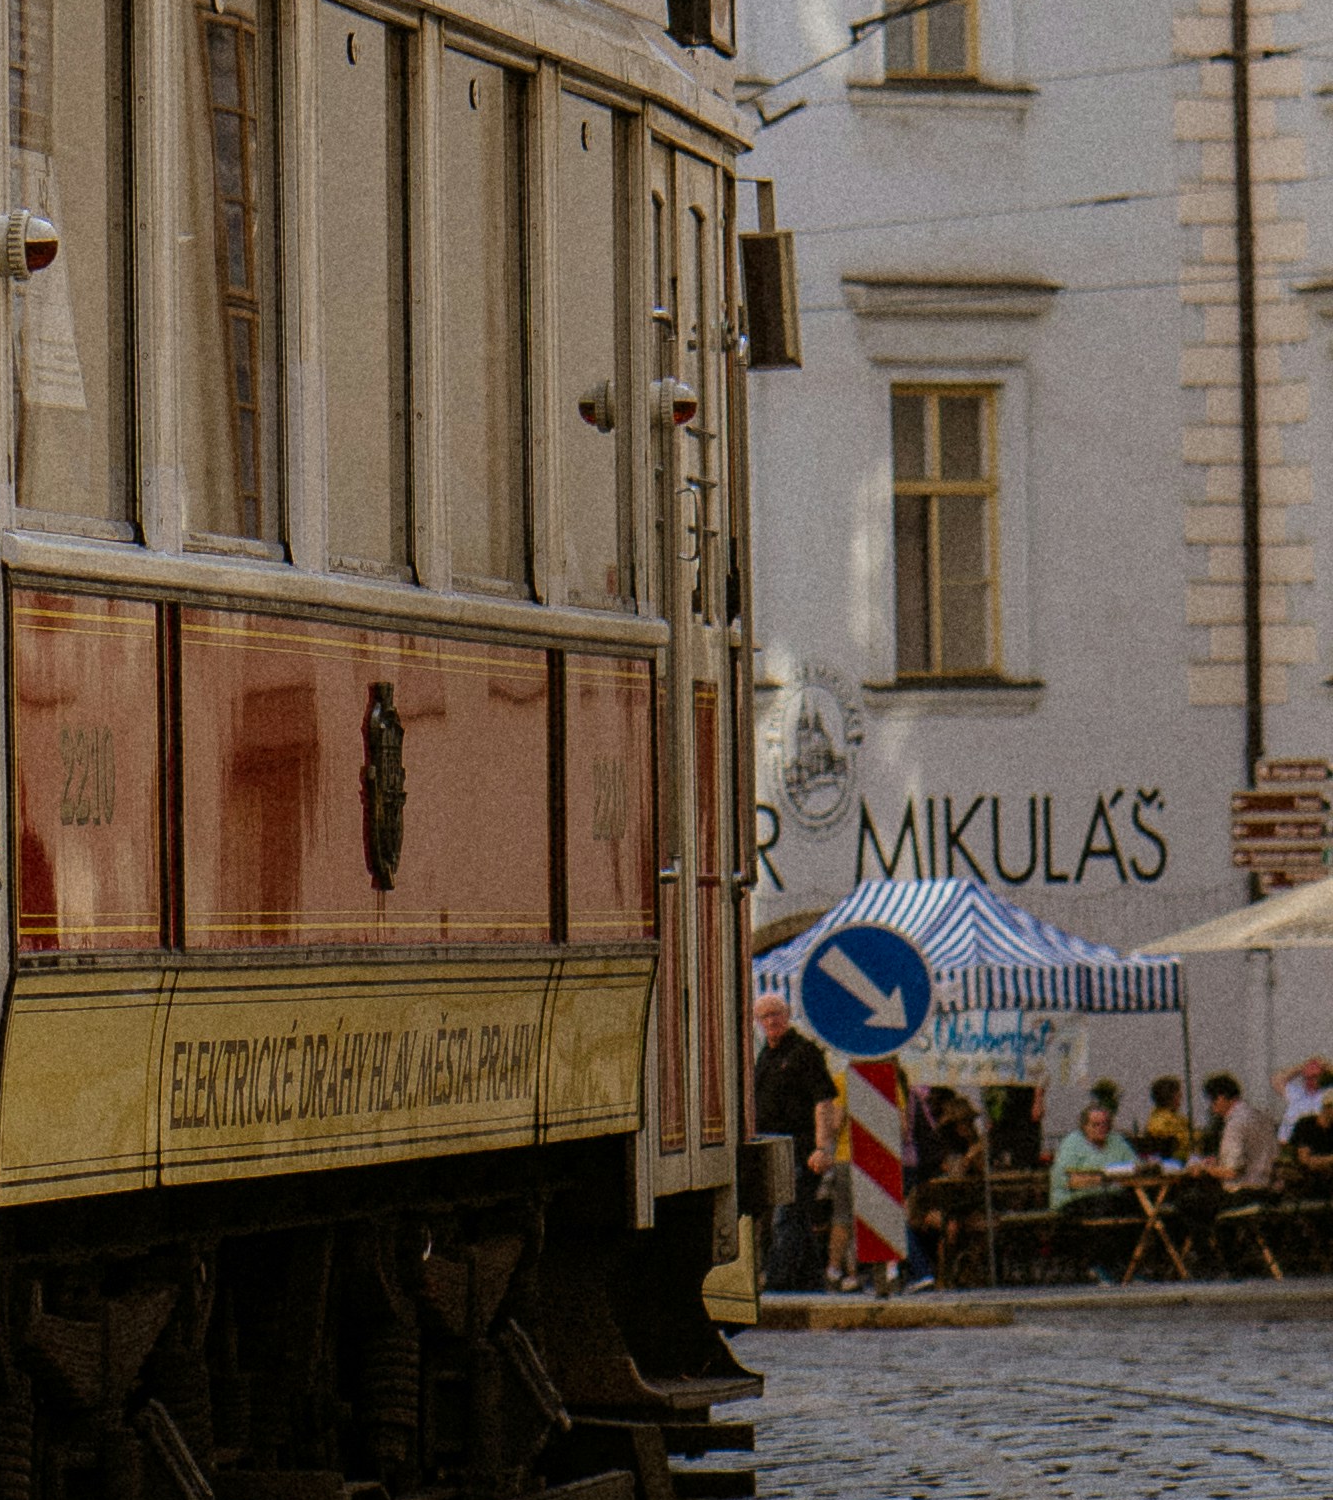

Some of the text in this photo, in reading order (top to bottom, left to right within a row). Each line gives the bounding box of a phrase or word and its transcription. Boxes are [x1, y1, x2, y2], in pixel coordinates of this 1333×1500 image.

[59, 722, 116, 827] 2210
[854, 787, 1169, 885] MIKULÁŠ
[169, 1019, 299, 1131] ELEKTRICKÉ
[297, 1016, 370, 1121] DRÁHY
[413, 1011, 474, 1109] MĚSTA
